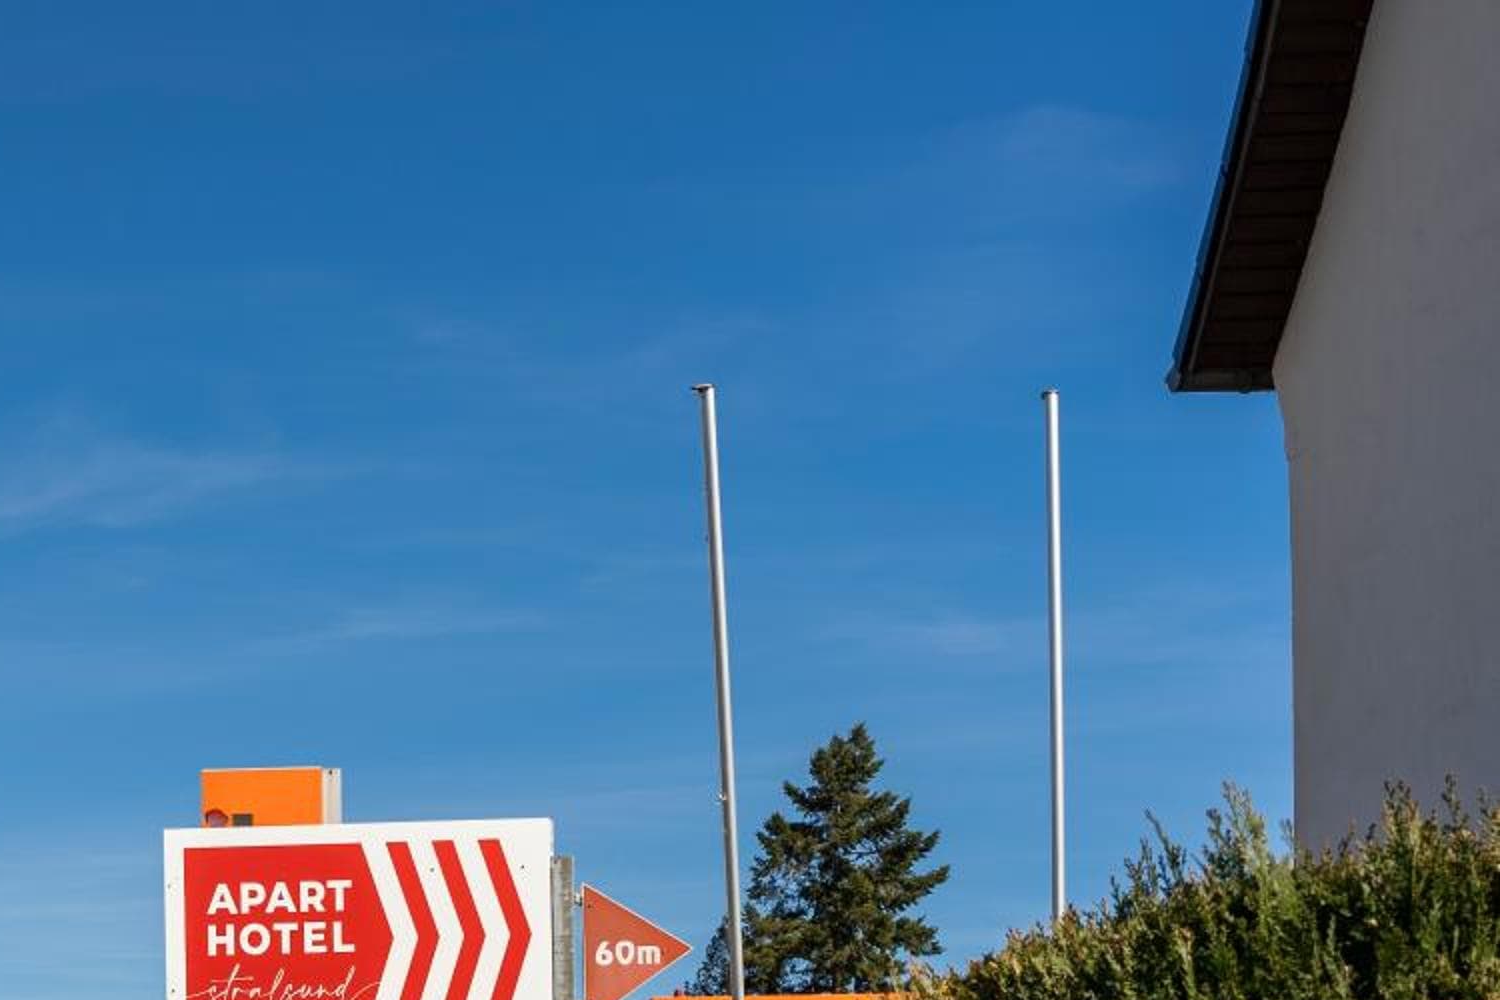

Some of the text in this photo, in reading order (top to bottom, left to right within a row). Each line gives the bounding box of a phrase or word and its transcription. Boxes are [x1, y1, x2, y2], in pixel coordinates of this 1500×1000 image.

[206, 879, 352, 915] APART
[206, 921, 356, 957] HOTEL
[595, 940, 662, 967] 60m
